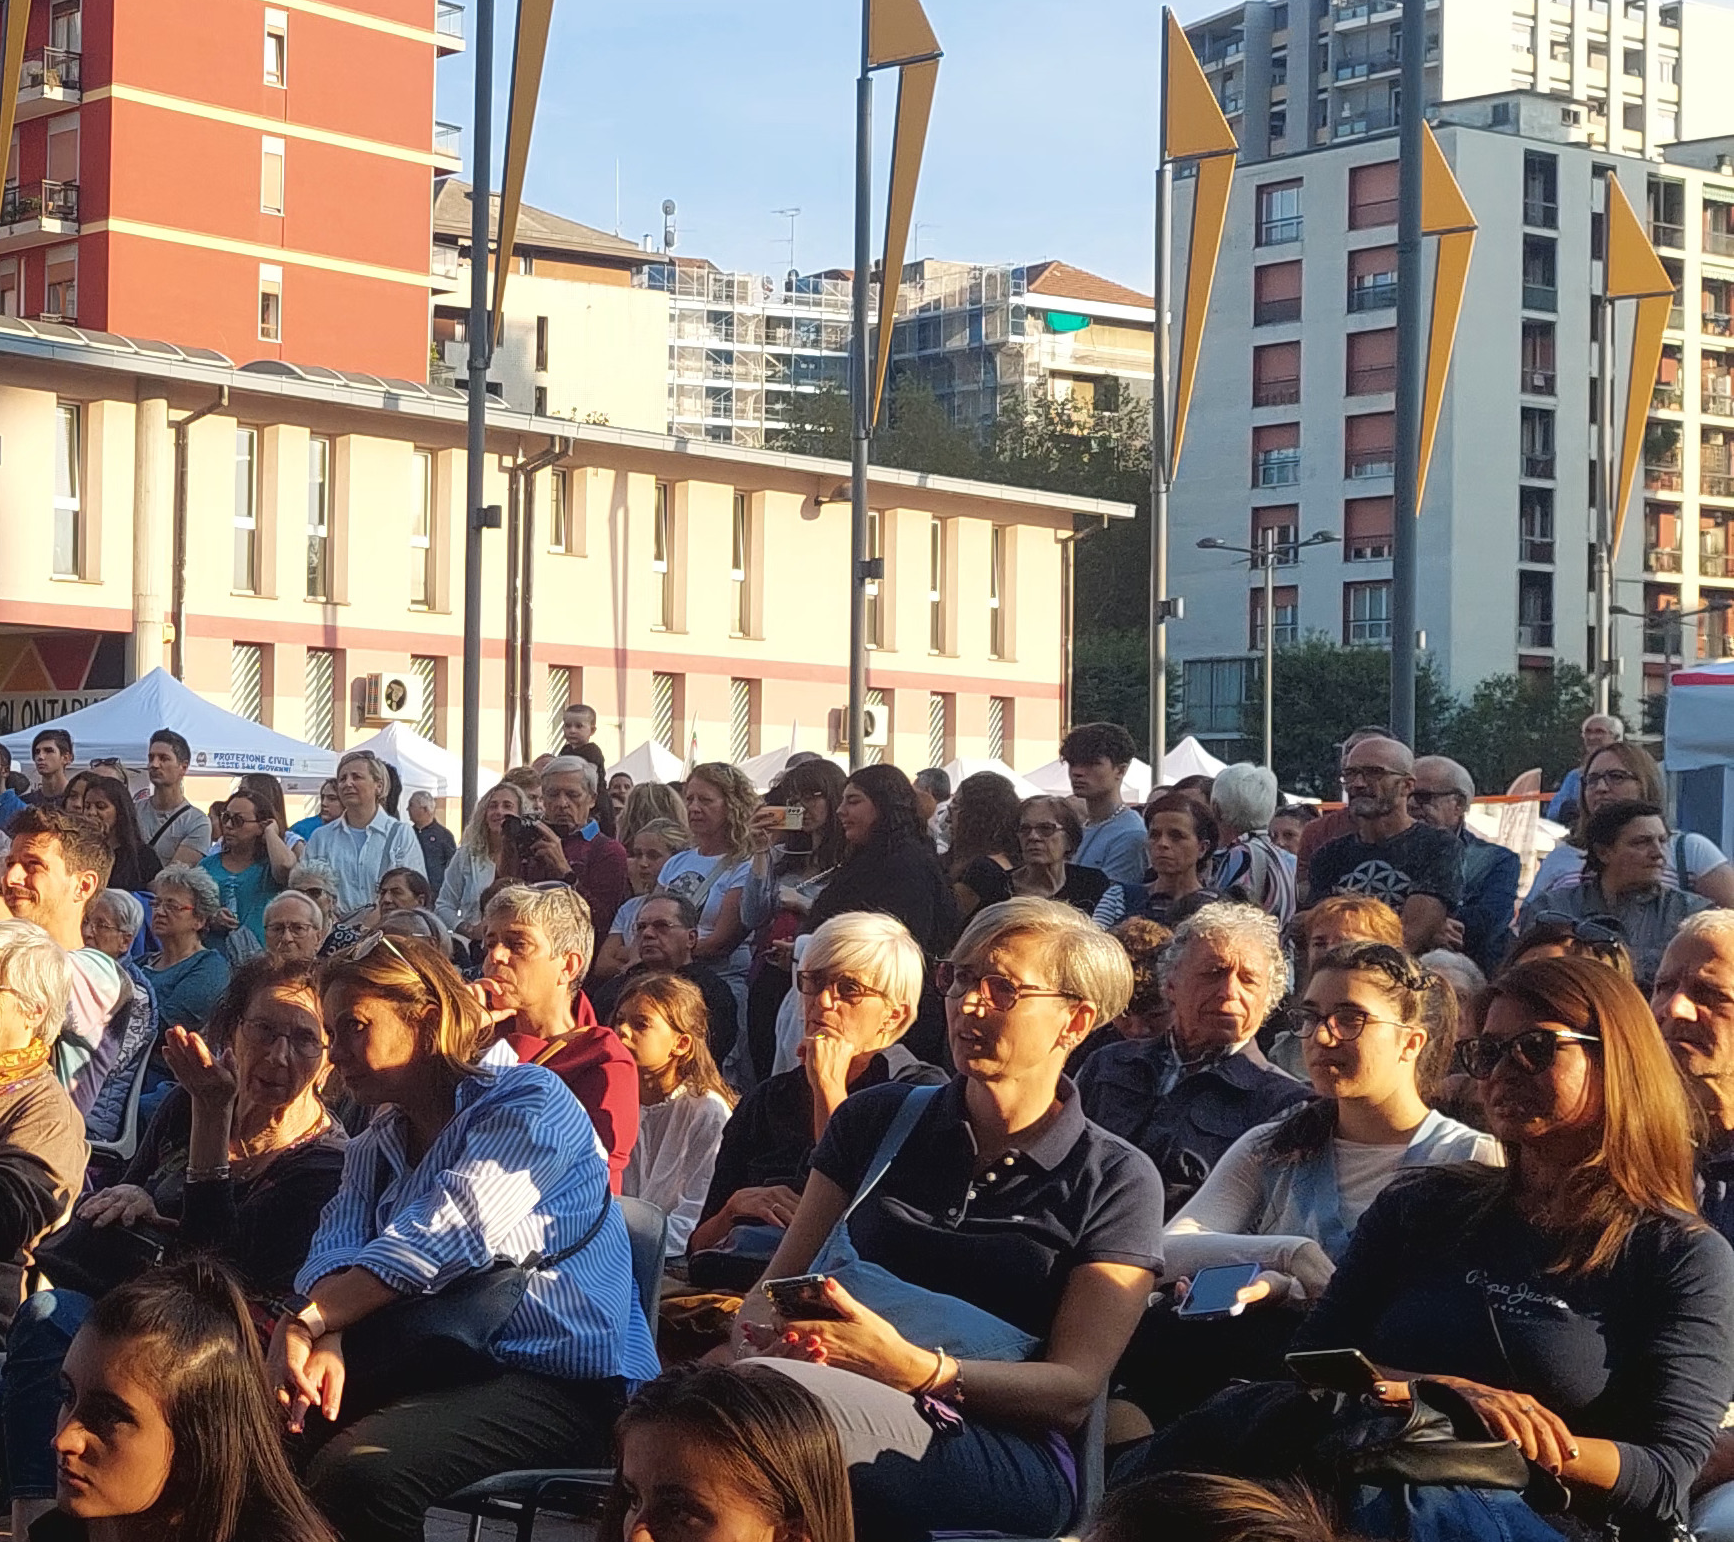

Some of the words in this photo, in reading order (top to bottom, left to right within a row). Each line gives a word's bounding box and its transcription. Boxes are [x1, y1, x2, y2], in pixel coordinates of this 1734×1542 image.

[213, 753, 266, 763] PROTEZIONE
[268, 756, 295, 766] CIVILE
[257, 763, 291, 773] GIOVANNI
